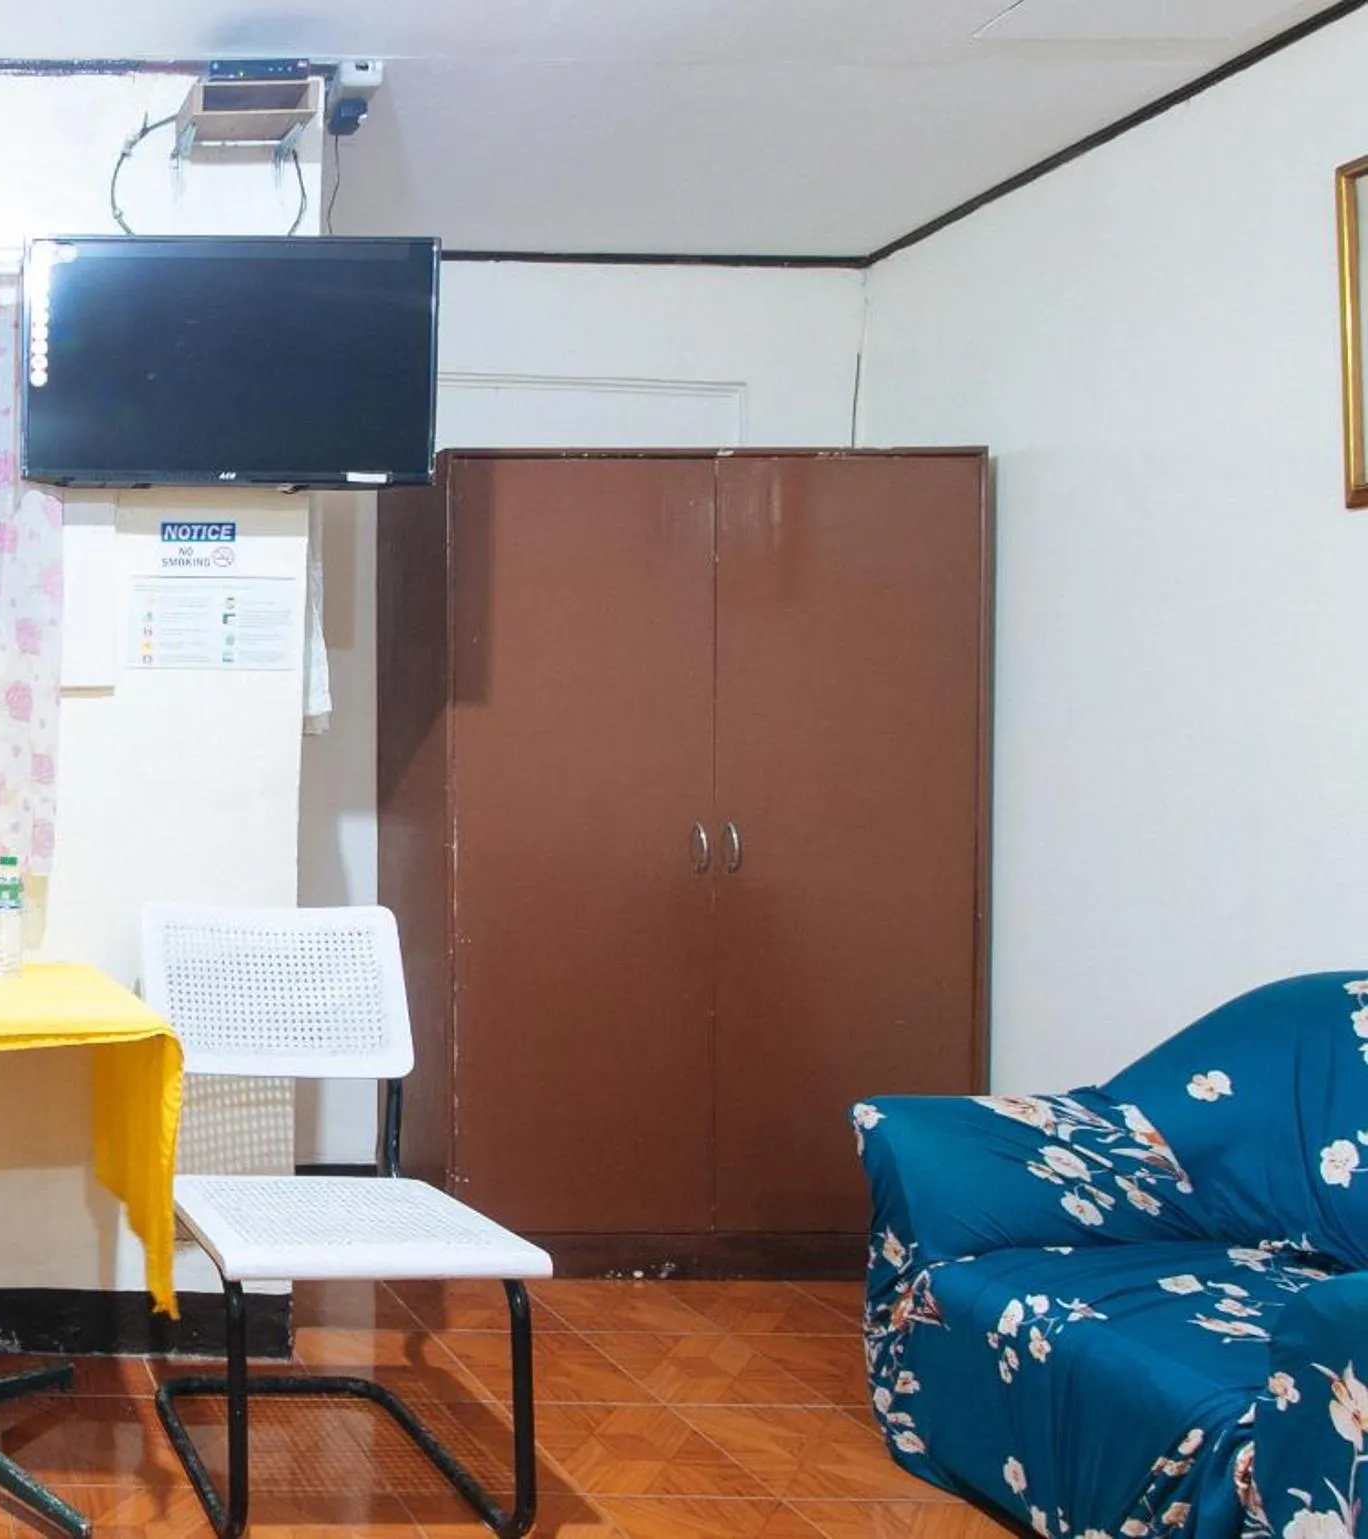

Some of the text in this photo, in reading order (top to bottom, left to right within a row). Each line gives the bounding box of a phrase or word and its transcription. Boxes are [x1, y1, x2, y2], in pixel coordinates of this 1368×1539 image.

[164, 524, 234, 541] NOTICE
[178, 546, 194, 557] NO
[161, 557, 211, 568] SMOKING
